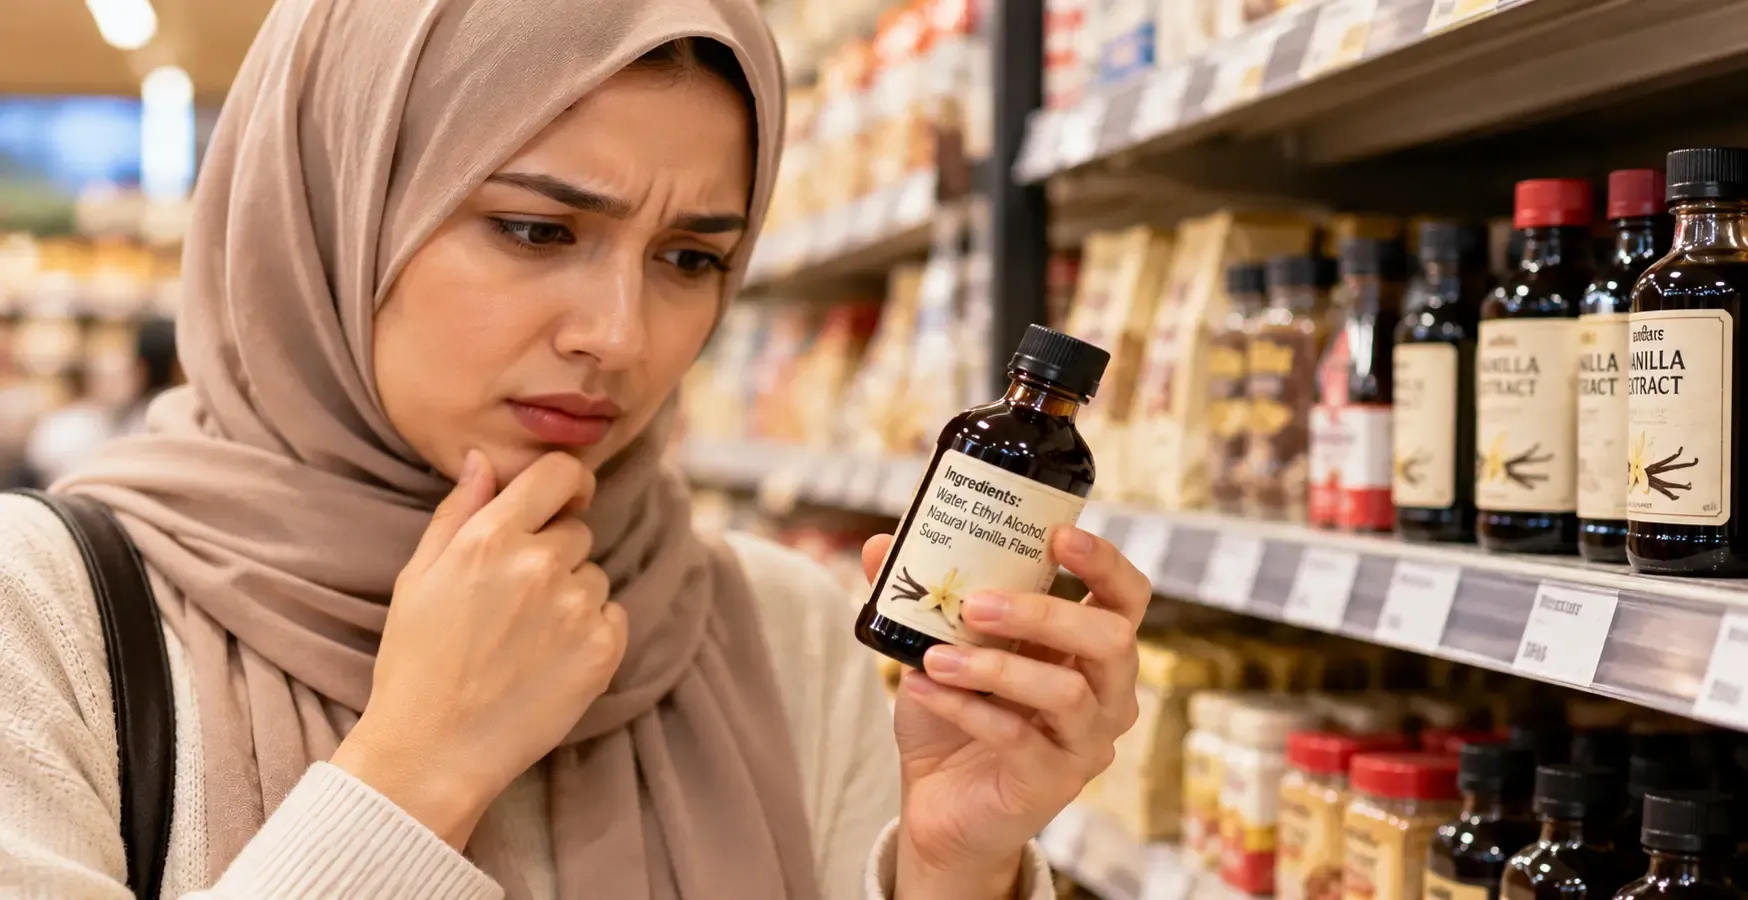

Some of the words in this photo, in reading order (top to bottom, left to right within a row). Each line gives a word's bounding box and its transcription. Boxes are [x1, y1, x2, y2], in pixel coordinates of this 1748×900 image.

[1630, 350, 1686, 371] ANILLA
[944, 465, 1022, 508] Ingredients:
[927, 504, 967, 531] Natural
[968, 521, 1007, 548] Vanilla
[1008, 537, 1043, 563] Flavor,
[936, 486, 968, 513] Water,
[971, 501, 1003, 525] Ethyl
[1003, 515, 1047, 543] Alcohol,
